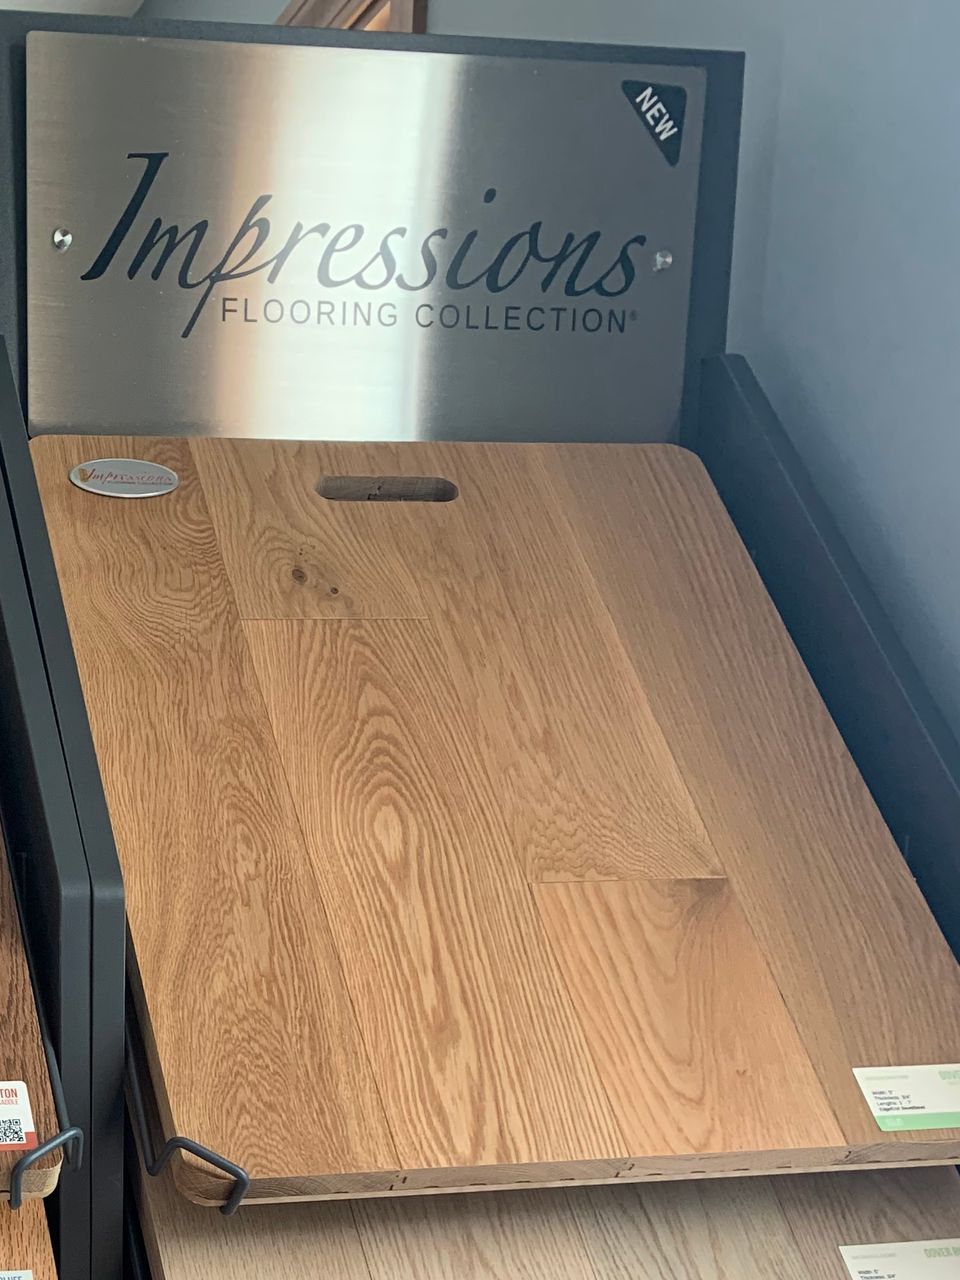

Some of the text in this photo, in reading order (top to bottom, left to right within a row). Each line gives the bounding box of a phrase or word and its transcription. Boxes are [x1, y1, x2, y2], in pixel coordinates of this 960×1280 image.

[634, 85, 678, 142] NEW
[80, 152, 646, 338] Impressions
[220, 297, 399, 328] FLOORING
[87, 468, 172, 485] Impressions
